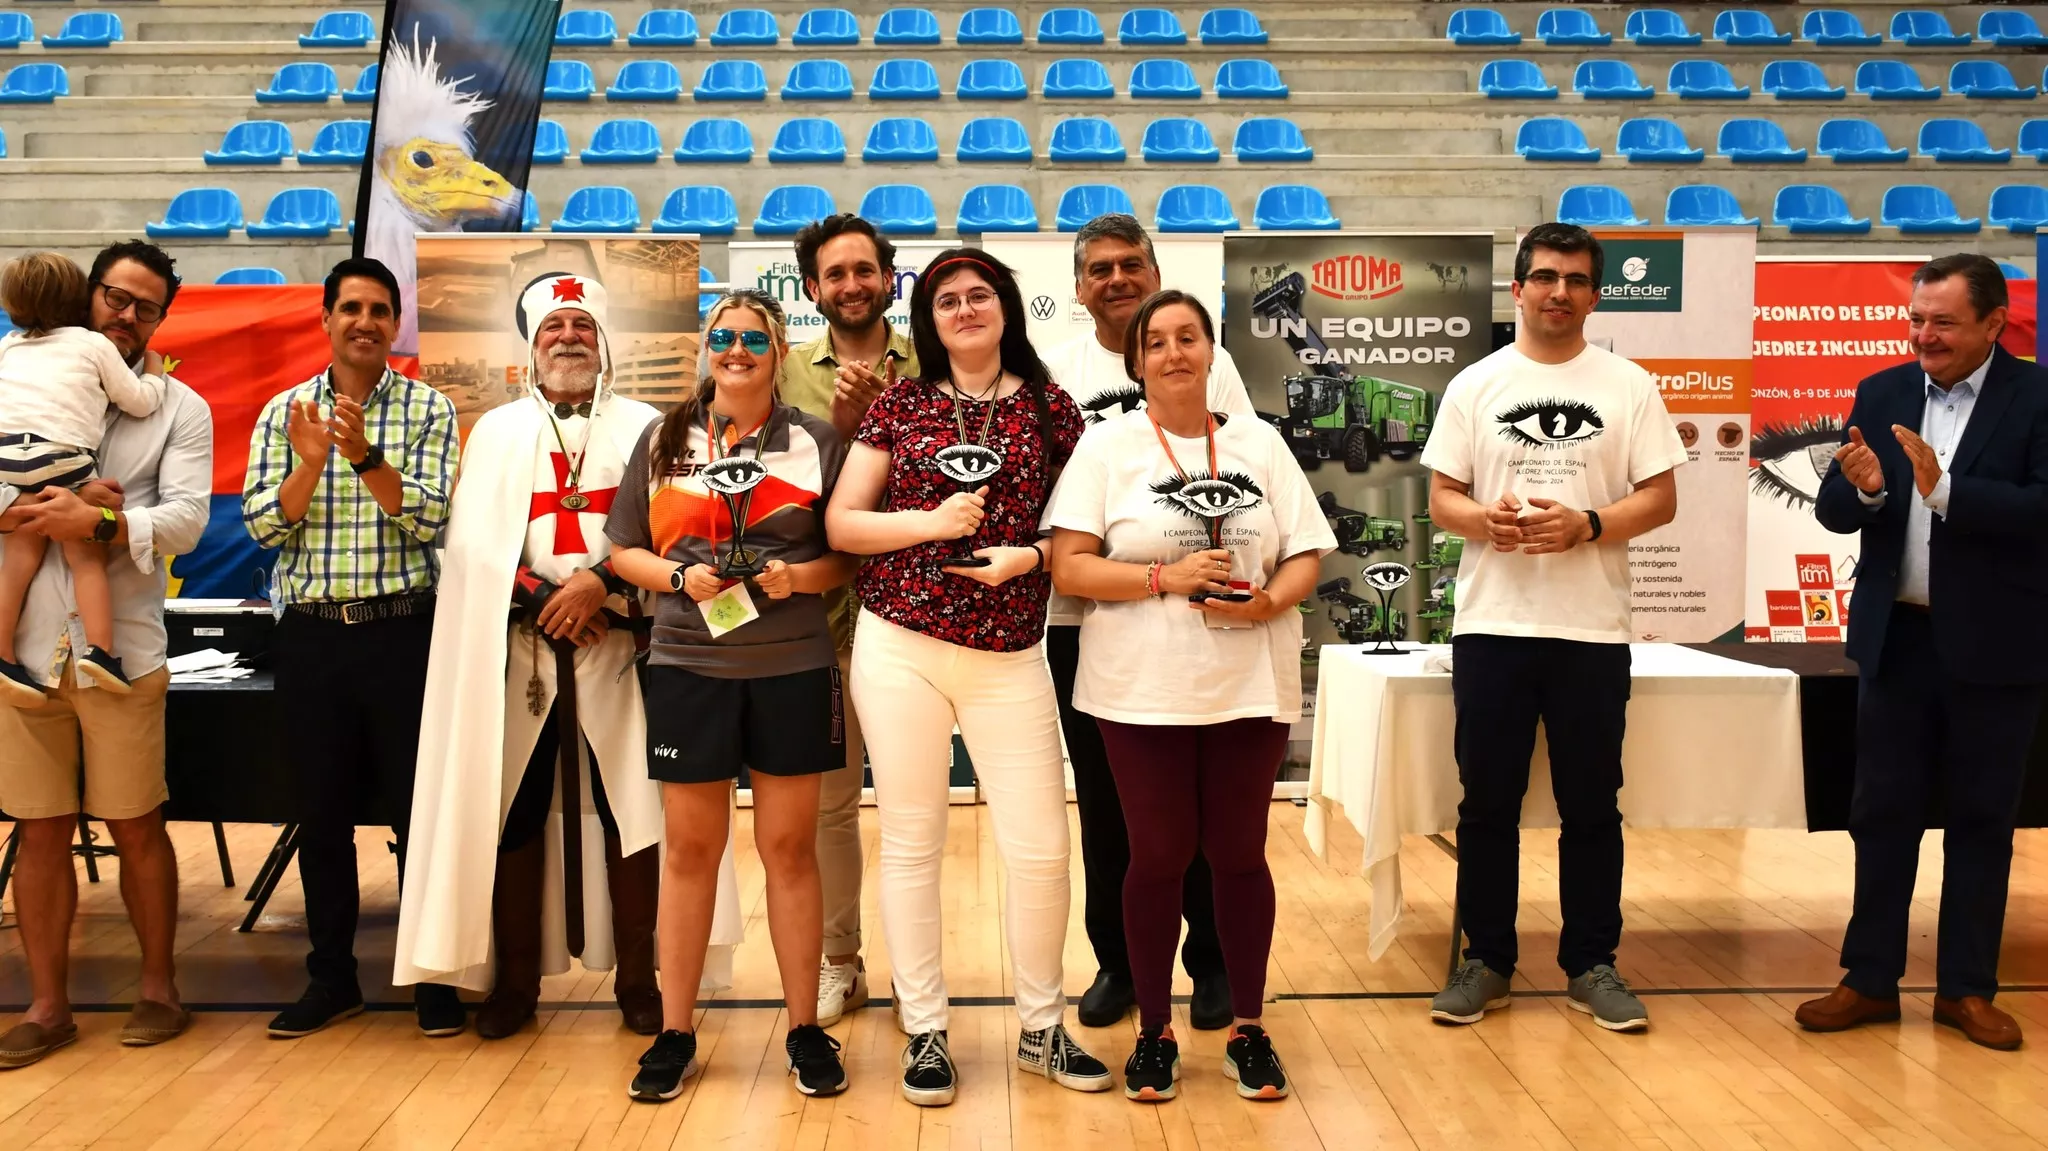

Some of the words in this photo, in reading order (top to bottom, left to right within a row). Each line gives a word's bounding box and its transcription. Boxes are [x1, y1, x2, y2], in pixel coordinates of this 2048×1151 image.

[1312, 255, 1402, 291] TATOMA
[1601, 284, 1671, 296] defeder
[1838, 305, 1861, 321] DE
[1250, 318, 1307, 338] UN
[1321, 317, 1471, 342] EQUIPO
[1299, 347, 1455, 365] GANADOR
[1817, 388, 1831, 398] DE
[1179, 539, 1209, 547] AJEDREZ
[1645, 545, 1680, 554] orgánica
[1637, 560, 1677, 569] nitrógeno
[1643, 575, 1683, 583] sostenida
[1800, 565, 1829, 582] itm
[1633, 590, 1671, 598] naturales
[1673, 591, 1679, 599] y
[1680, 590, 1706, 598] nobles
[654, 744, 678, 759] vive
